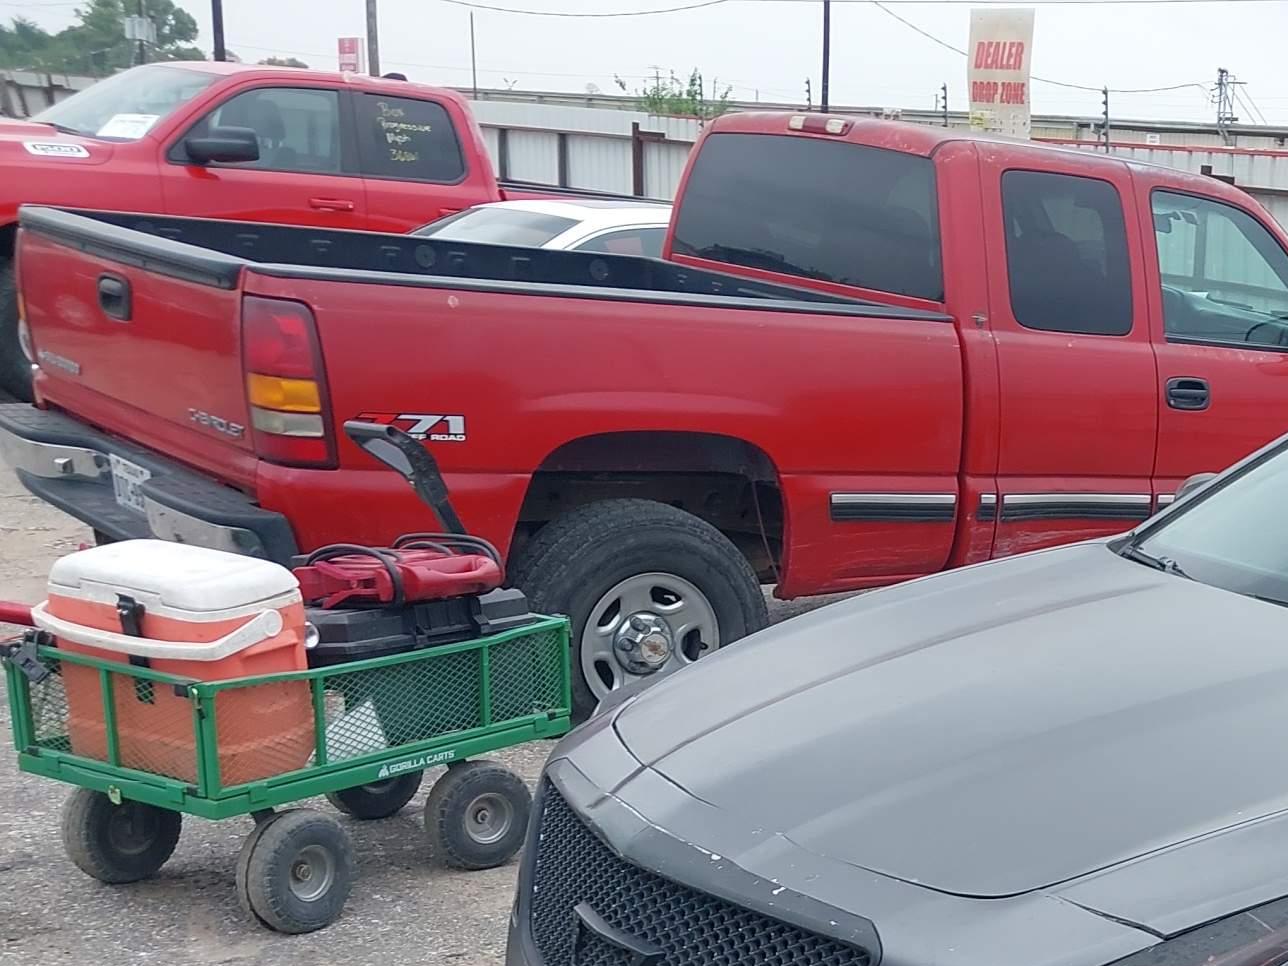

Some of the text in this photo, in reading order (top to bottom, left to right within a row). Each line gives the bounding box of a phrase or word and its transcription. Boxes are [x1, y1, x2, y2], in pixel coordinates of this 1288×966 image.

[974, 41, 1025, 70] DEALER
[972, 81, 1025, 104] DROP ZONE
[389, 750, 455, 773] GORILLA CARTS
